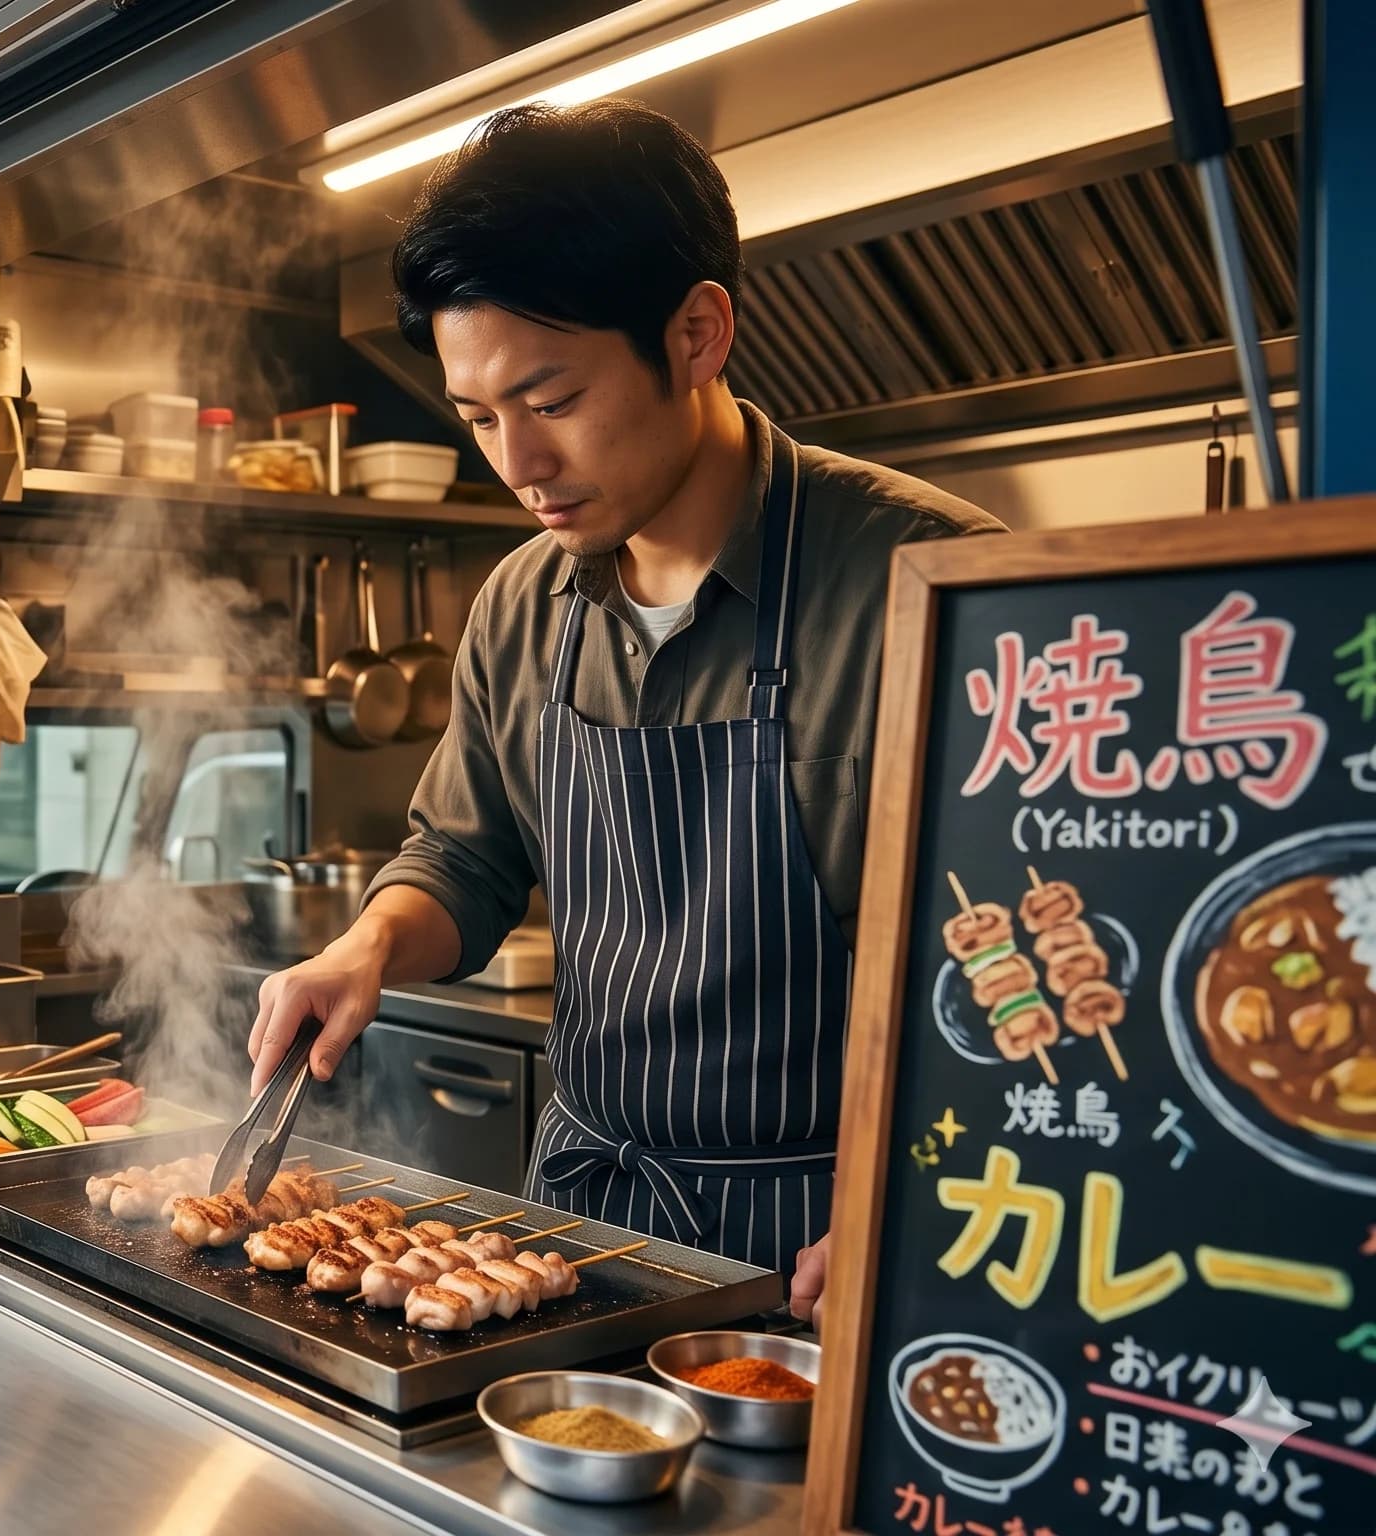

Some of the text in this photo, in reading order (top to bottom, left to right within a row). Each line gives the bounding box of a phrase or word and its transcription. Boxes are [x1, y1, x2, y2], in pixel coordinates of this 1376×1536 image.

[960, 590, 1328, 811] 焼鳥
[1012, 804, 1239, 855] (Yakitori)
[1002, 1081, 1122, 1148] 焼鳥
[936, 1144, 1354, 1322] カレー
